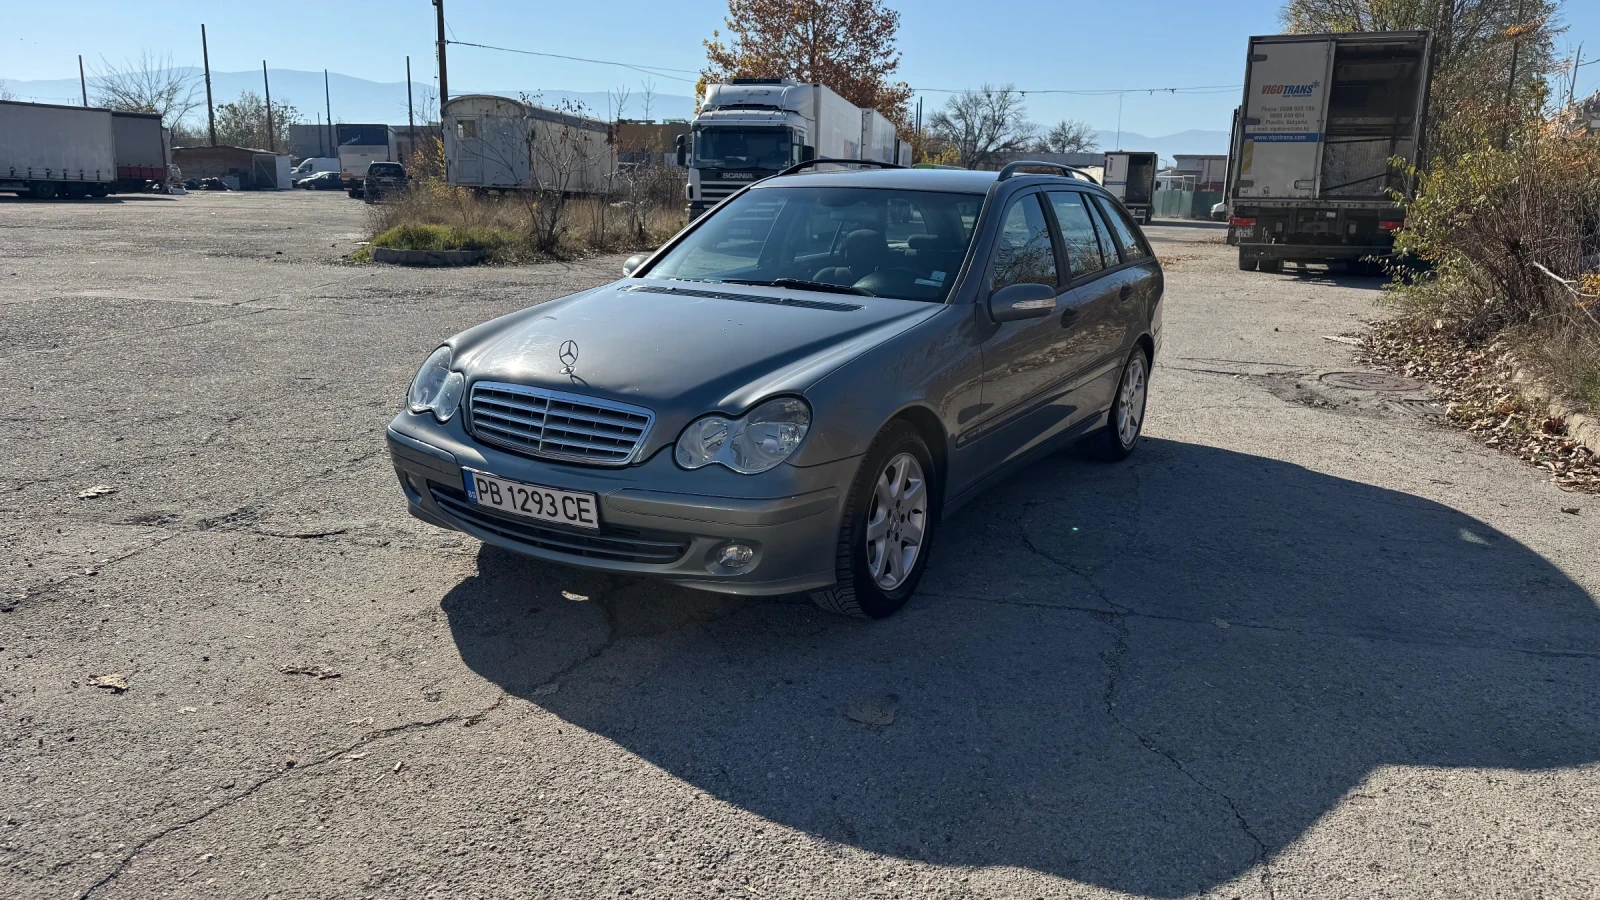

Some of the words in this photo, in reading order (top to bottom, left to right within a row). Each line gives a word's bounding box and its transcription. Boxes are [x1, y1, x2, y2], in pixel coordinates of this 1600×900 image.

[1261, 84, 1313, 95] VIGOTRANS
[476, 477, 503, 506] PB
[507, 485, 558, 518] 1293
[561, 496, 594, 524] CE
